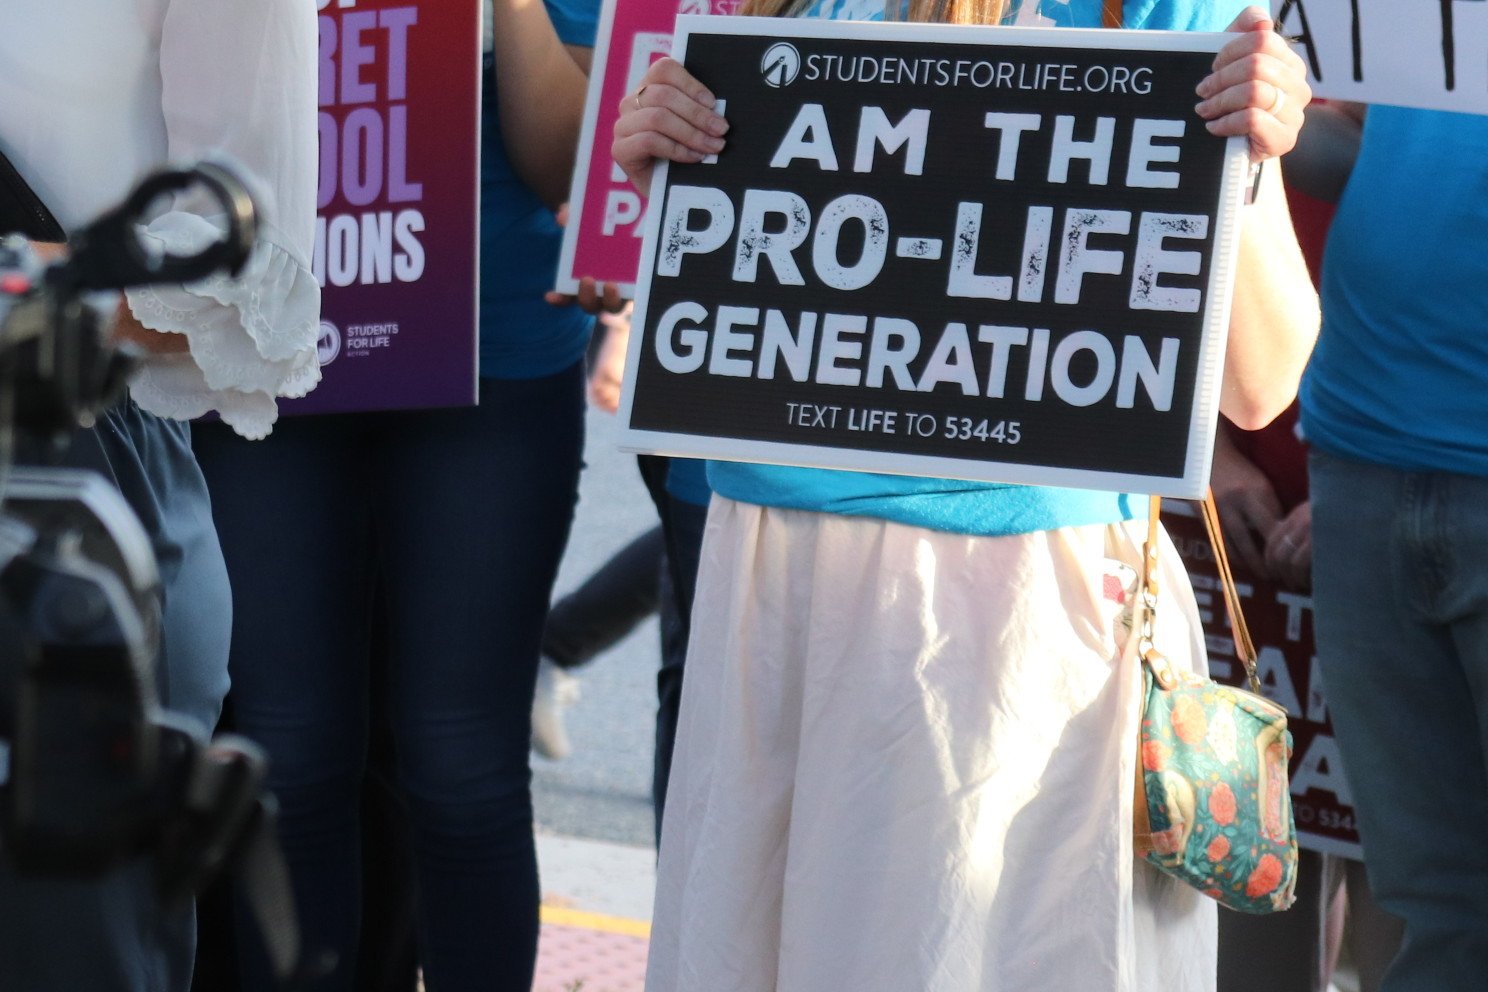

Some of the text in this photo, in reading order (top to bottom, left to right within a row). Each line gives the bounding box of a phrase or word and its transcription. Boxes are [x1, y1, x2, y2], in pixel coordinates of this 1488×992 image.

[804, 53, 1155, 96] STUDENTSFORLIFE.ORG
[768, 103, 932, 177] AM
[983, 110, 1187, 190] THE
[656, 184, 1210, 314] PRO-LIFE
[346, 323, 400, 338] STUDENTS
[346, 336, 391, 349] FOR LIFE
[654, 300, 1181, 413] GENERATION
[786, 401, 1022, 446] TEXT LIFE TO 53445
